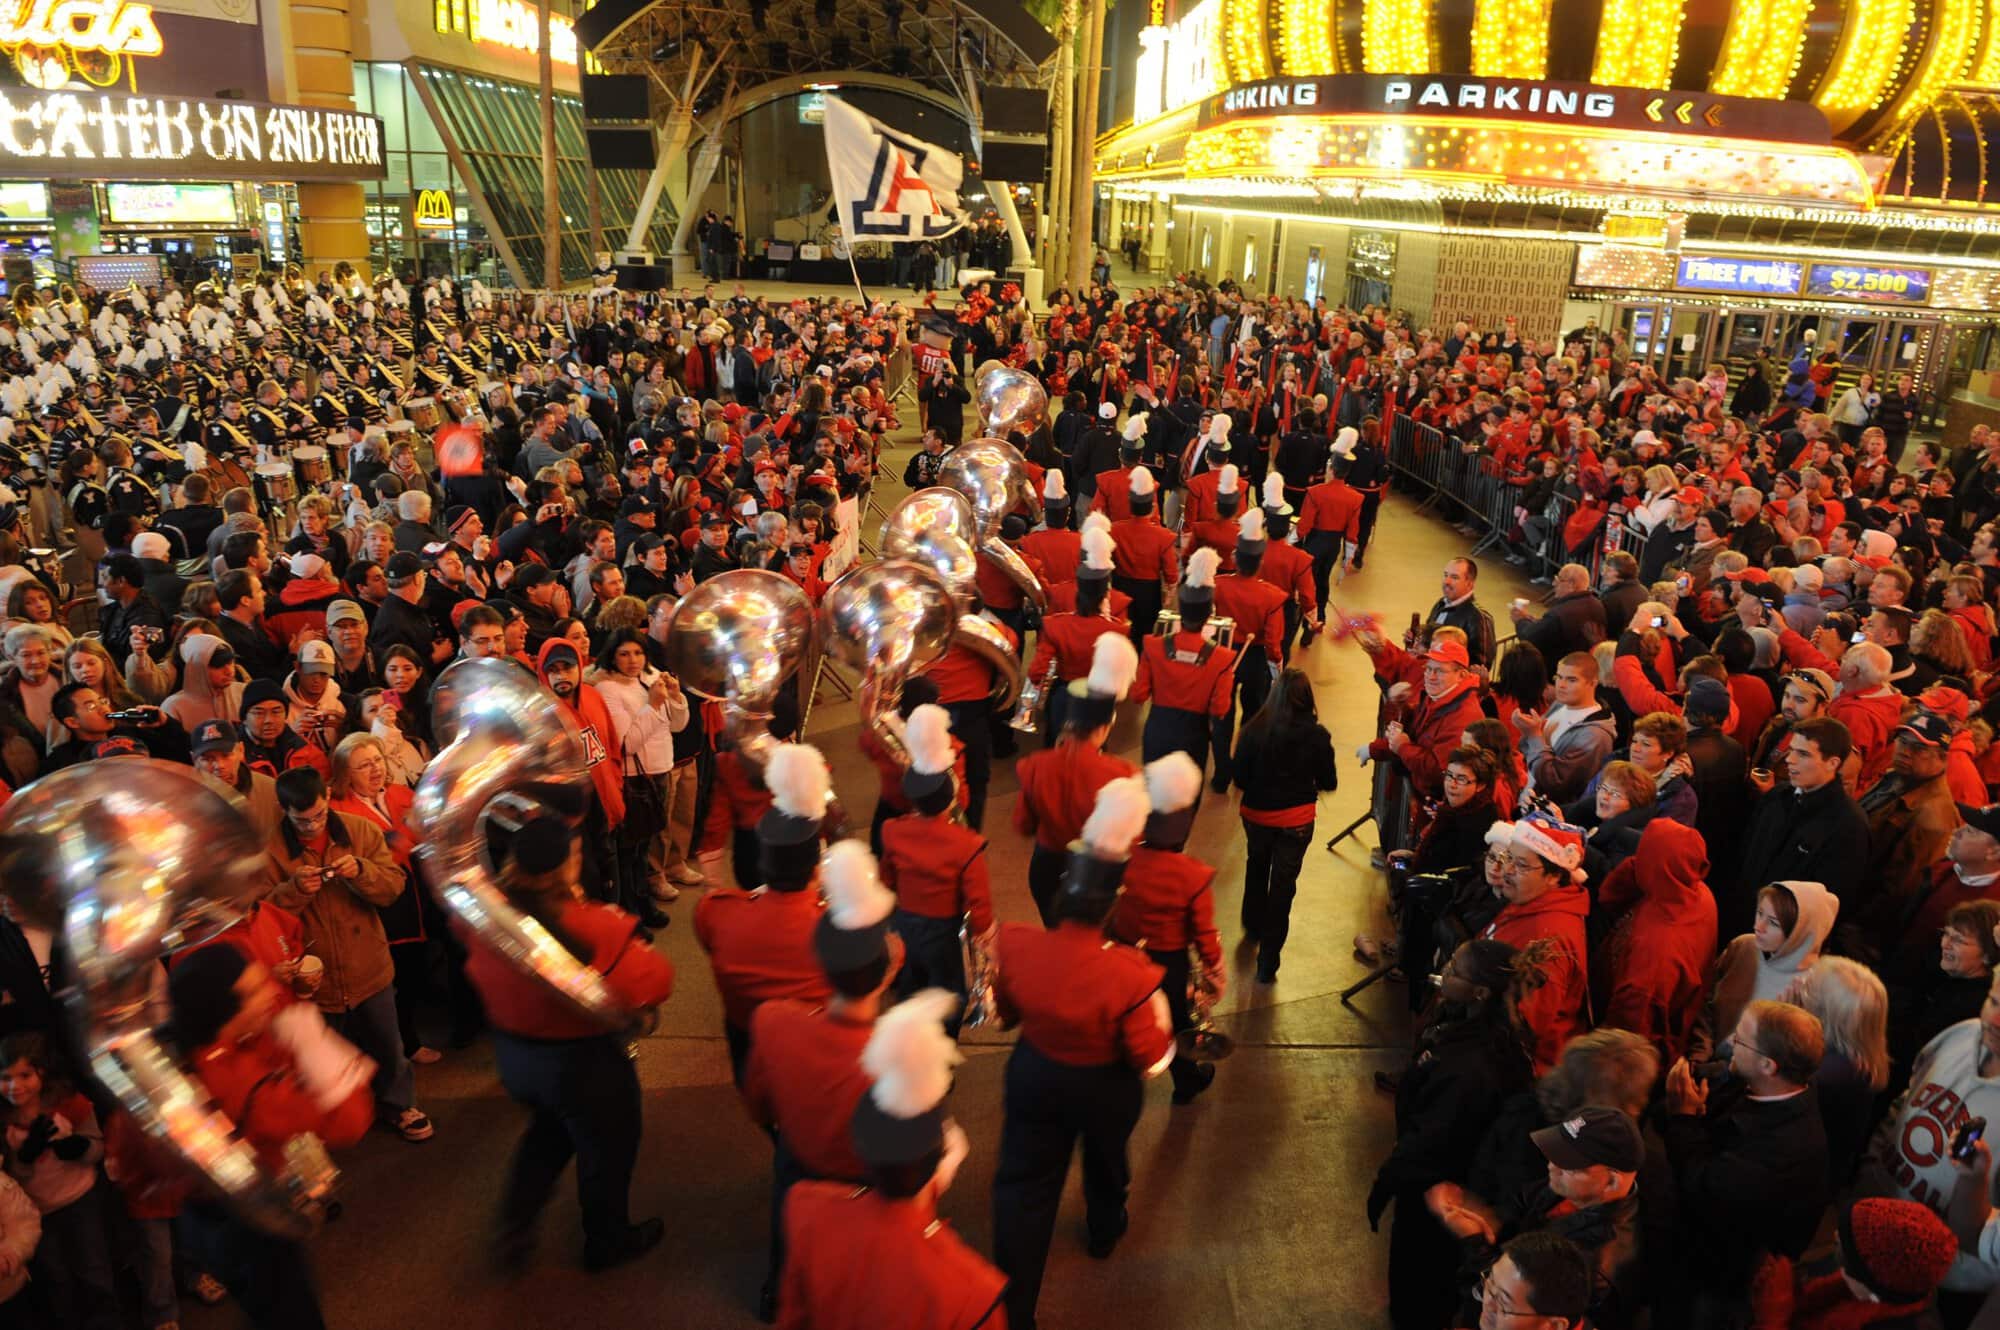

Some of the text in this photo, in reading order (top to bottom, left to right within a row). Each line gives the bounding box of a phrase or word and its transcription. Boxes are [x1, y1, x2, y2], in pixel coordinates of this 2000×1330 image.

[1384, 82, 1616, 118] PARKING
[1686, 261, 1737, 283] FREE
[1829, 269, 1909, 293] $2,500
